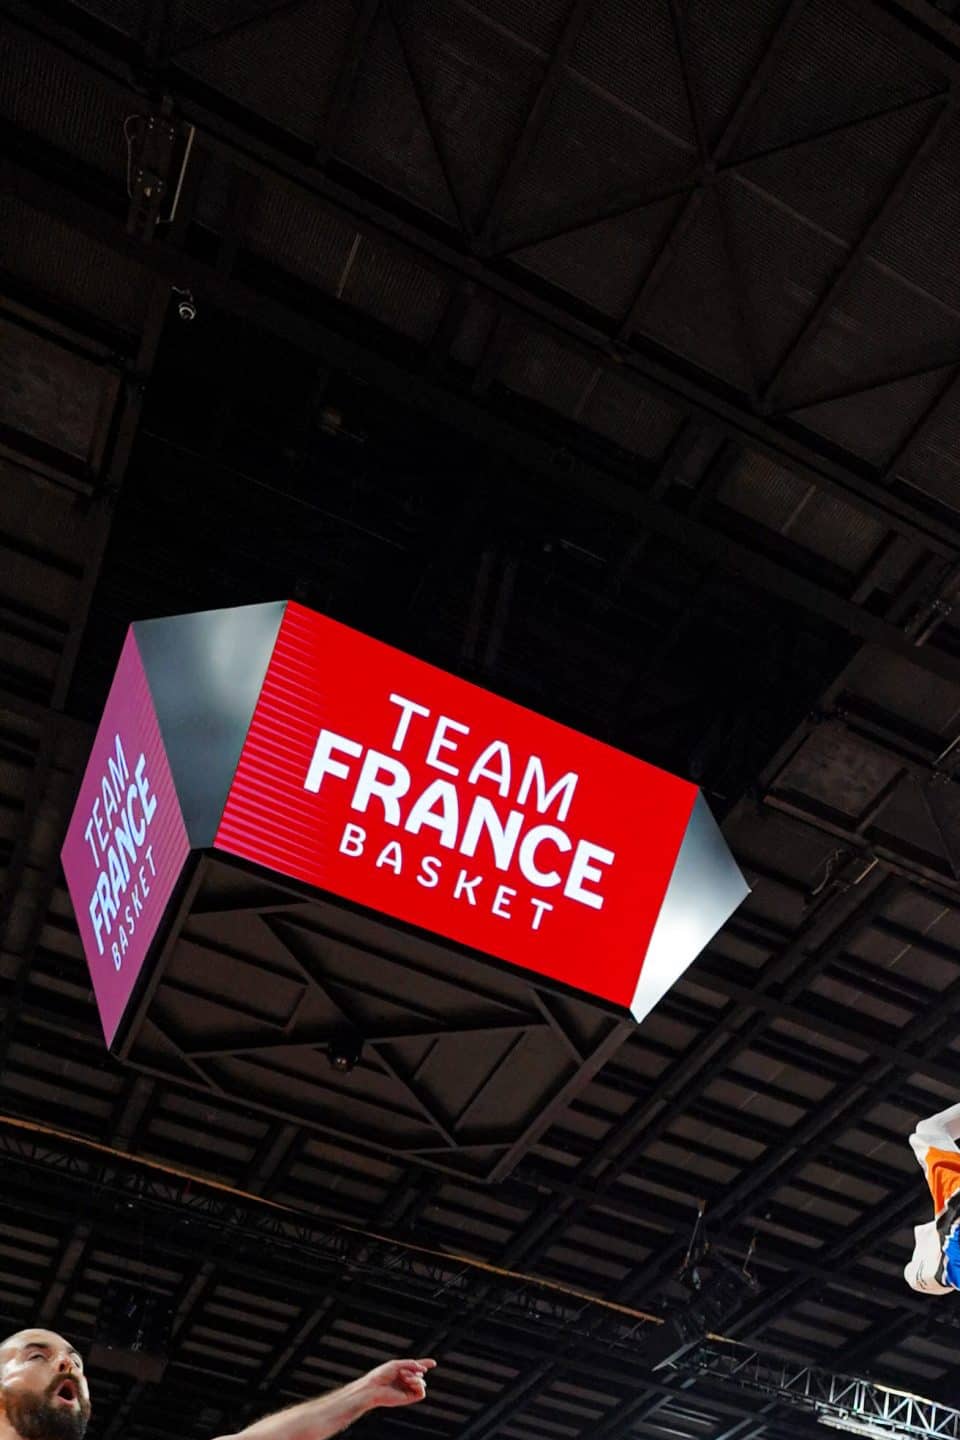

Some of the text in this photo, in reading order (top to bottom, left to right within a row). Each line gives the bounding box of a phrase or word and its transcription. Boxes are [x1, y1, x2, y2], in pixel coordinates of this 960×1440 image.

[84, 733, 130, 868] TEAM
[303, 728, 616, 911] FRANCE
[389, 692, 579, 822] TEAM
[89, 752, 157, 956] FRANCE
[111, 845, 156, 972] BASKET
[338, 822, 554, 931] BASKET
